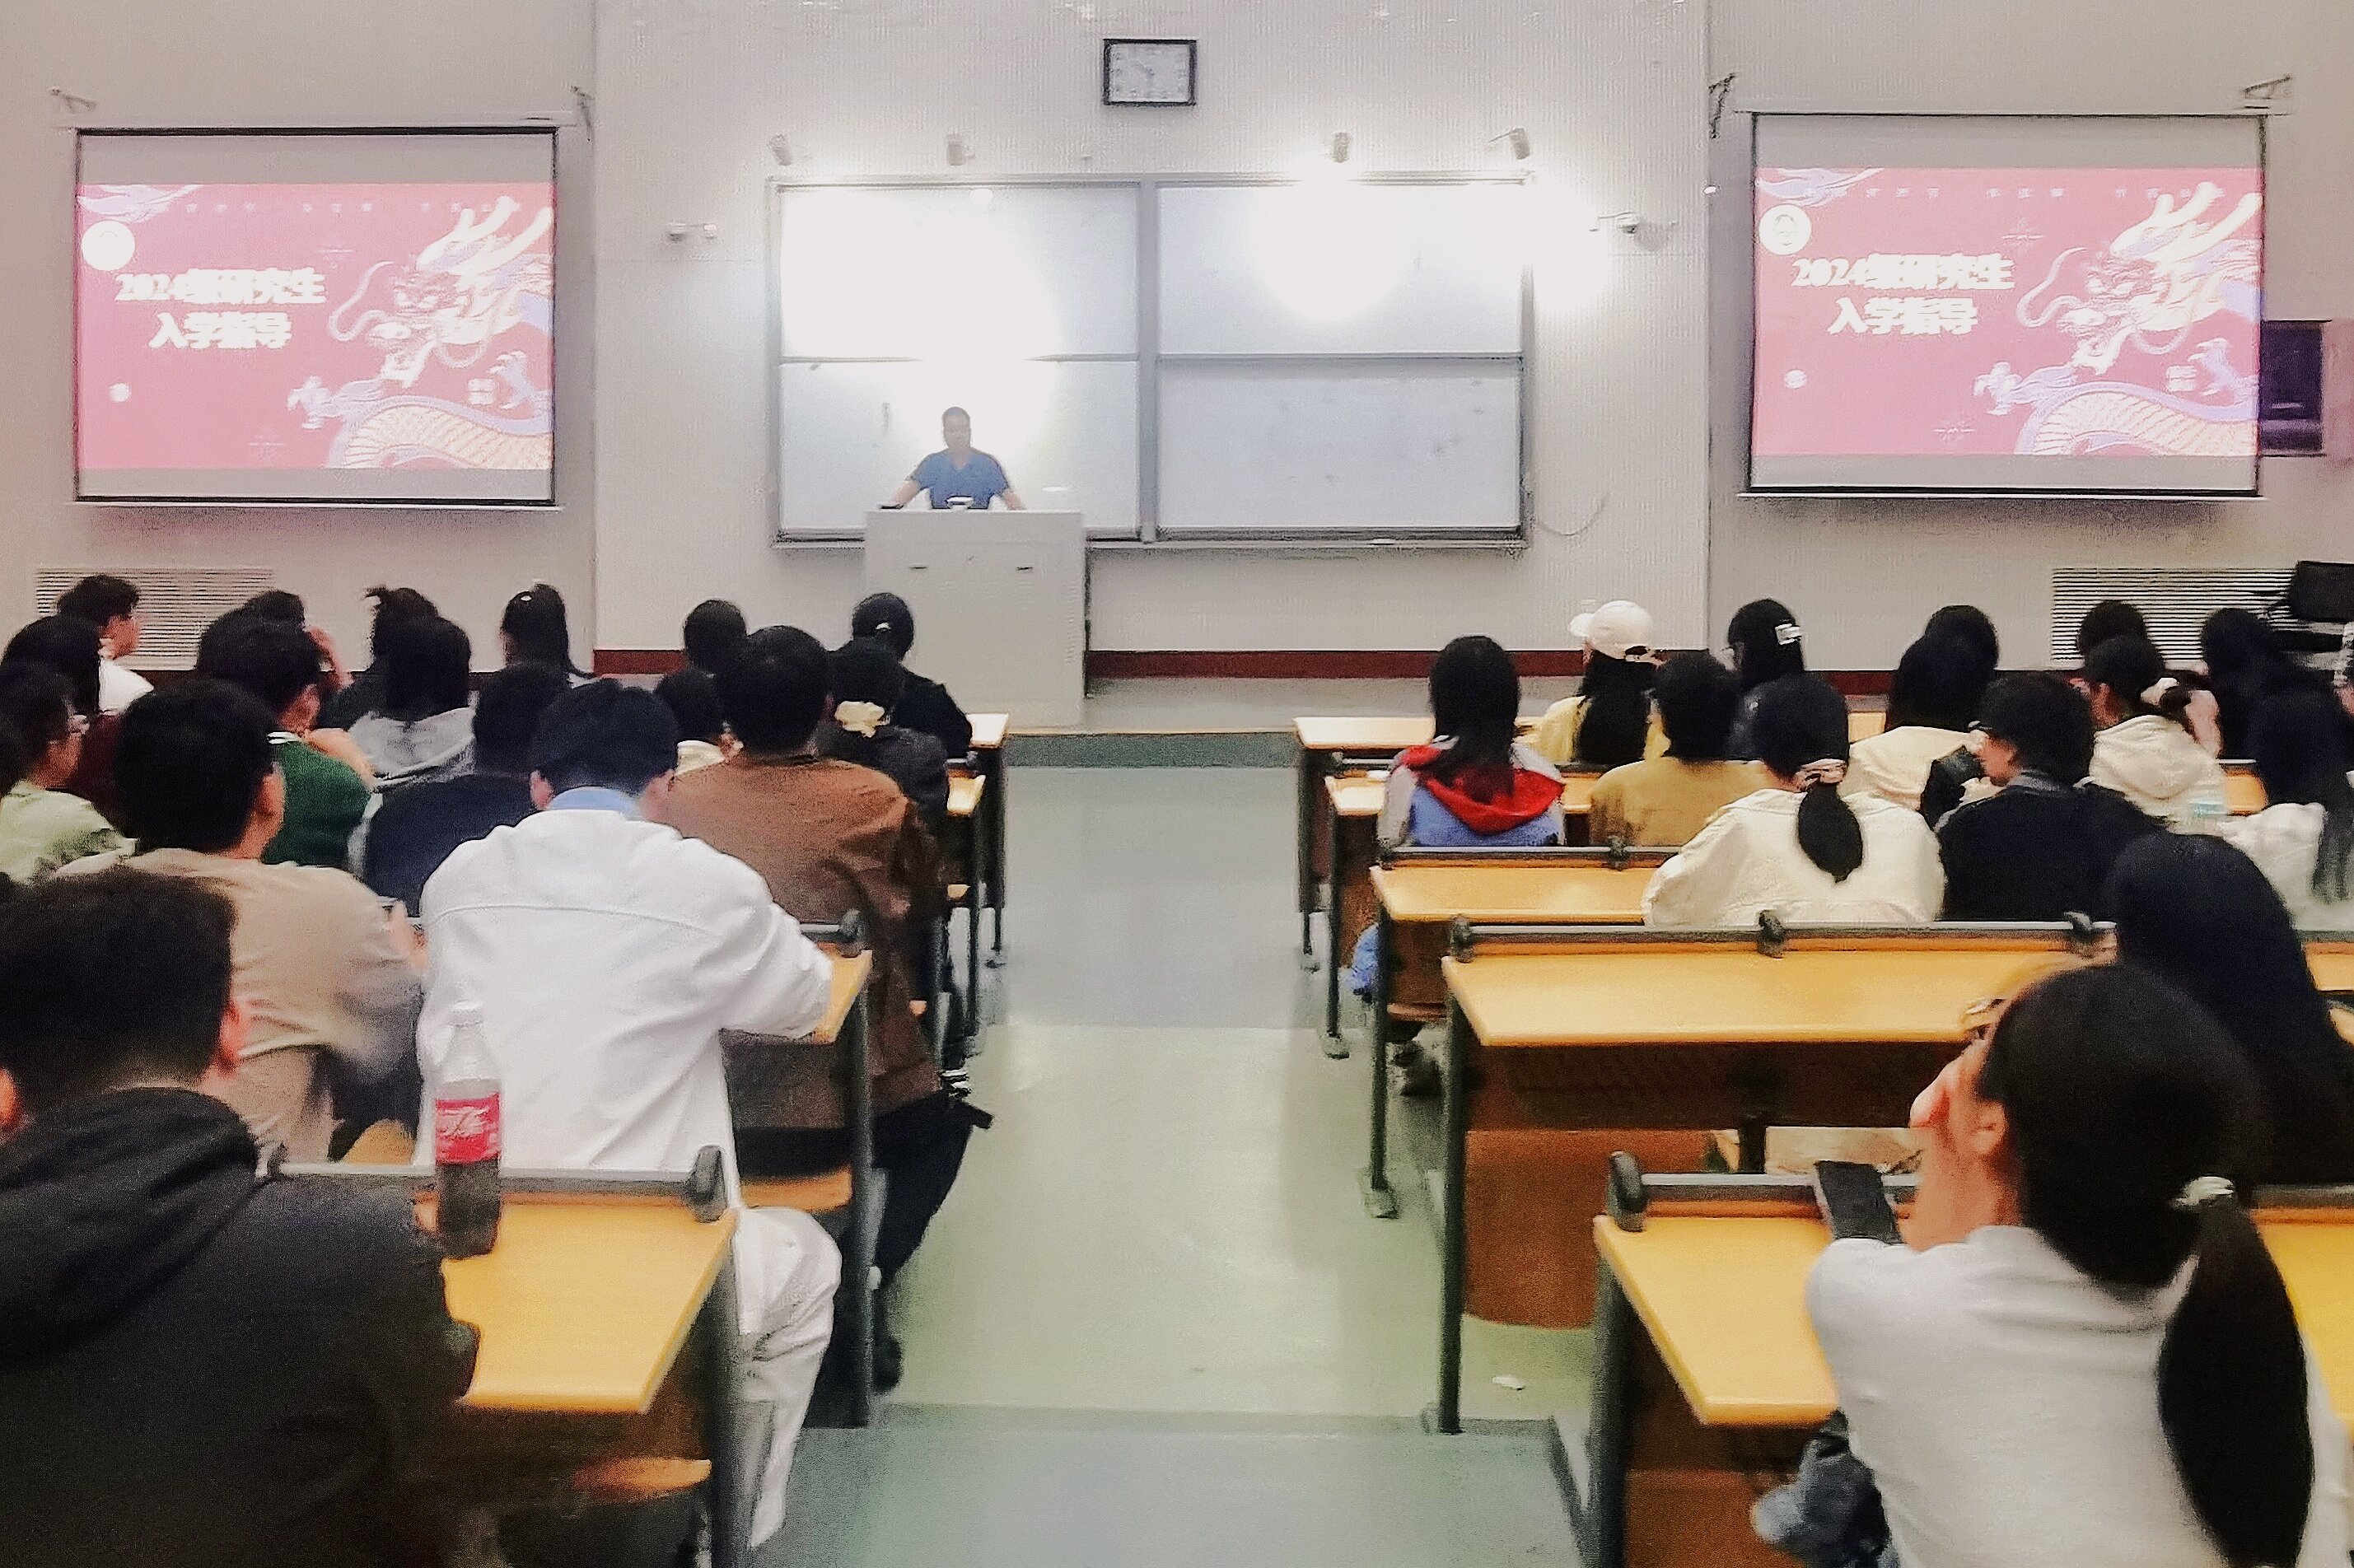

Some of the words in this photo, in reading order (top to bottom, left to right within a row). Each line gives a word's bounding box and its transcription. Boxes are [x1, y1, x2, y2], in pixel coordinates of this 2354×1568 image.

[148, 311, 292, 349] 入学指导
[1827, 296, 1978, 335] 入学指导
